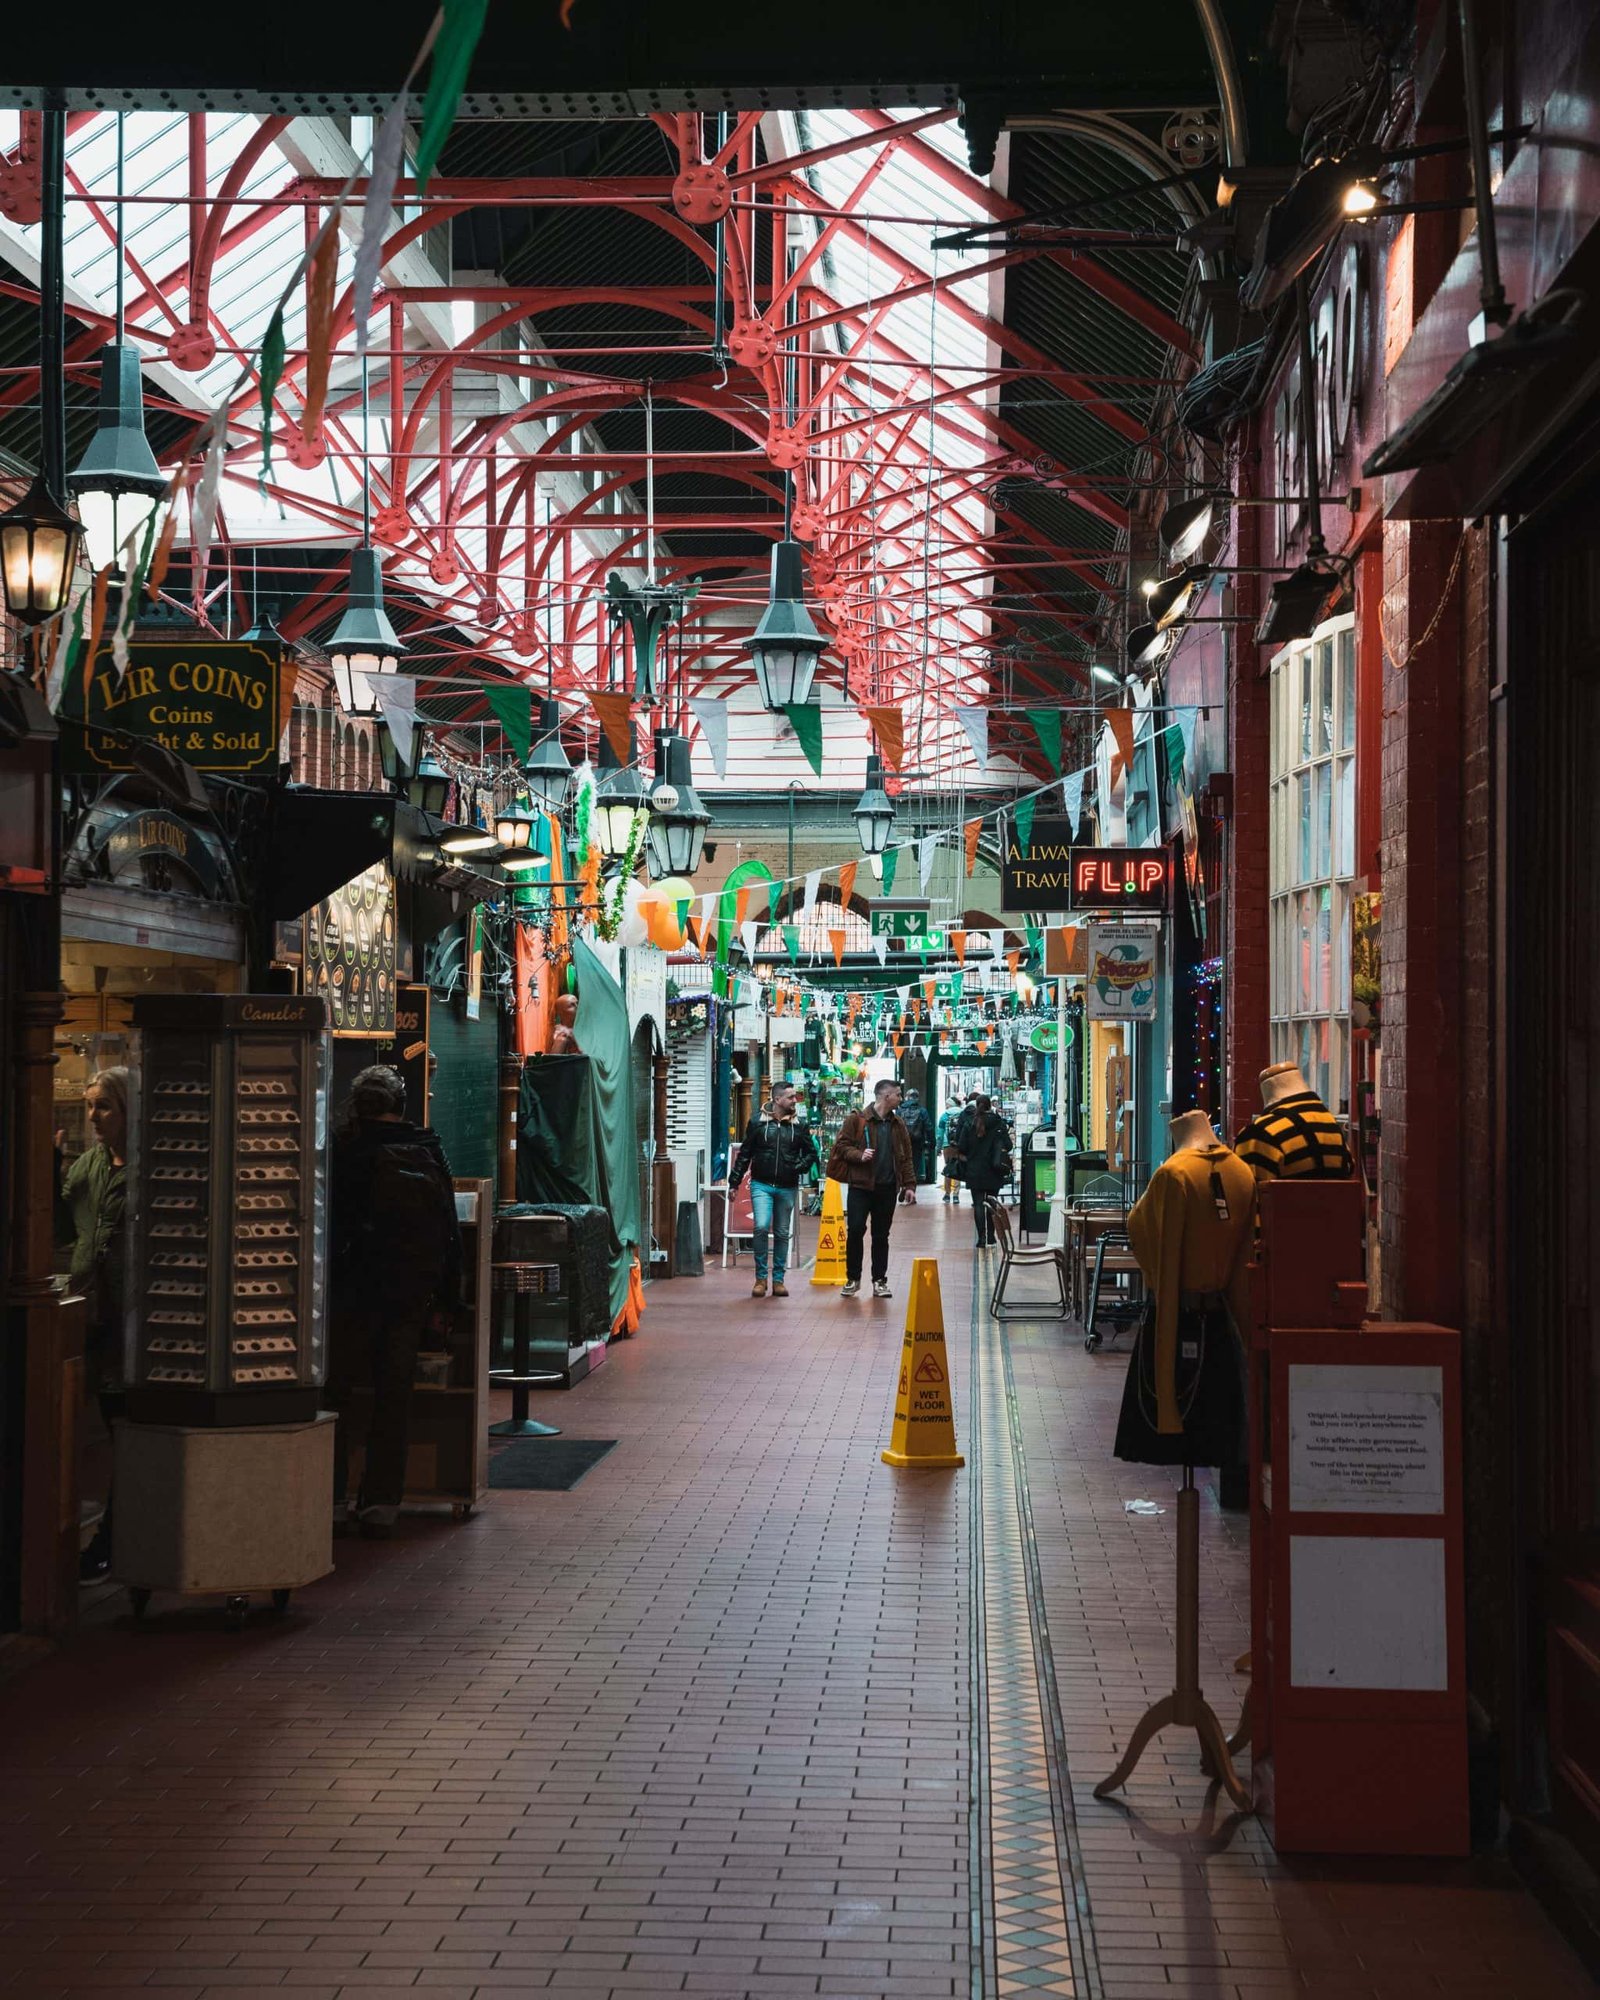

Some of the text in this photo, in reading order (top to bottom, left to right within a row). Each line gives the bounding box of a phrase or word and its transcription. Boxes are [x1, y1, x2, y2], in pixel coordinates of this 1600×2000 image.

[169, 662, 267, 710] COINS
[149, 705, 214, 724] Coins
[102, 732, 261, 750] Boht & Sold
[158, 820, 188, 857] COINS
[241, 1002, 307, 1022] Camelot
[914, 1331, 944, 1343] CAUTION
[919, 1390, 940, 1399] WET
[914, 1401, 945, 1410] FLOOR
